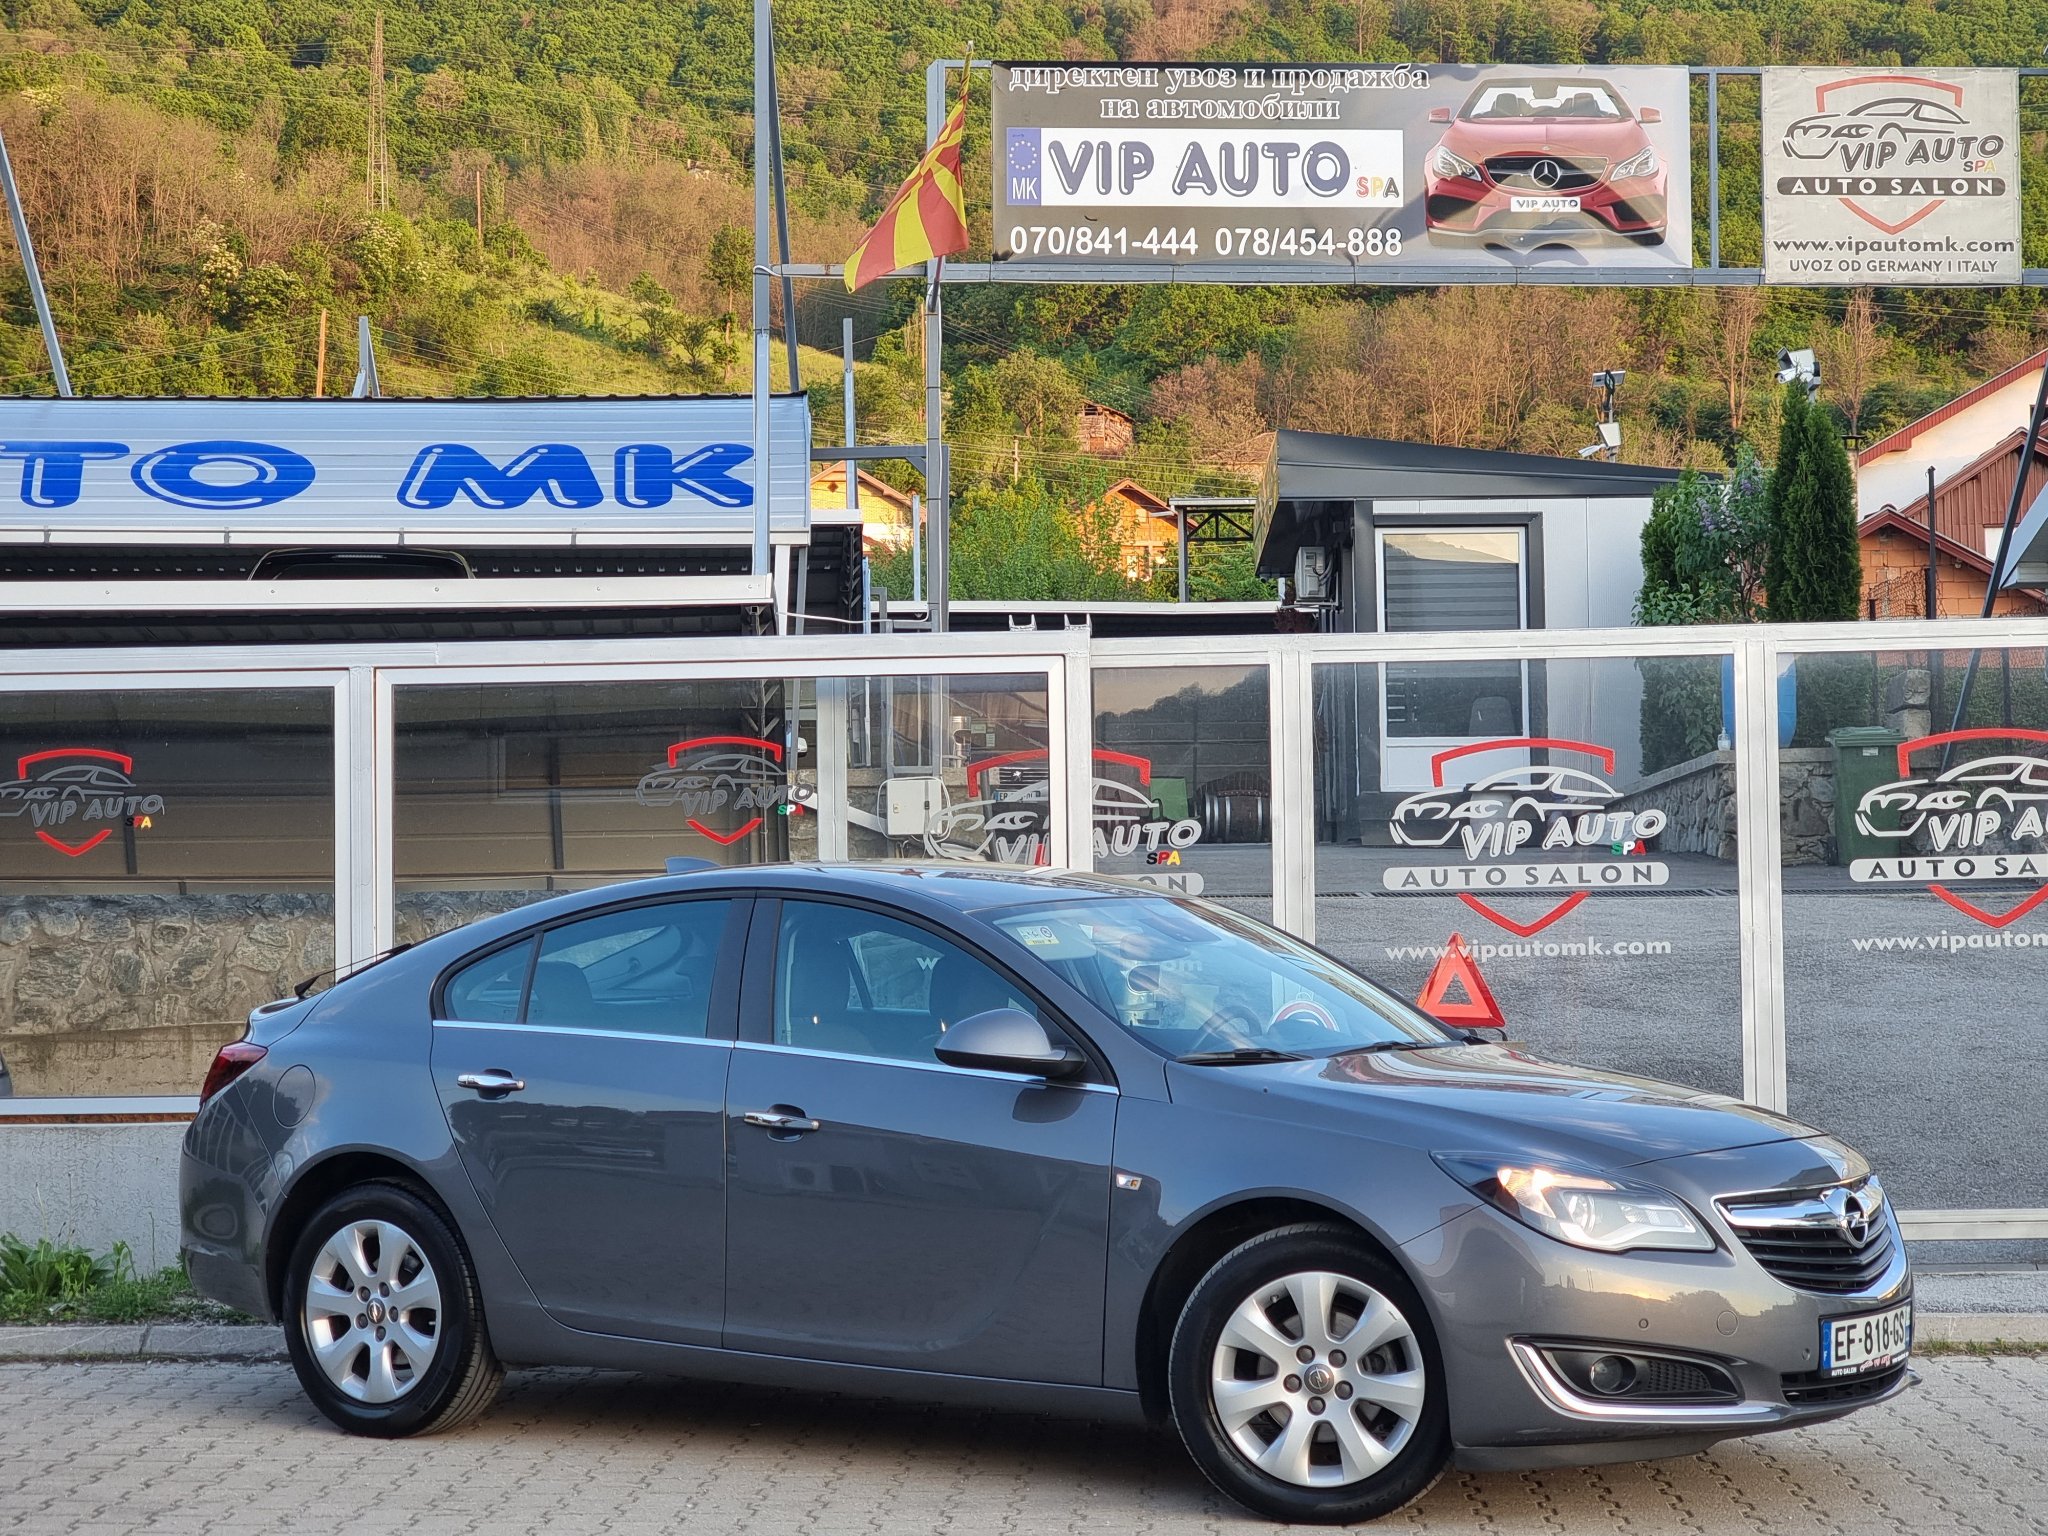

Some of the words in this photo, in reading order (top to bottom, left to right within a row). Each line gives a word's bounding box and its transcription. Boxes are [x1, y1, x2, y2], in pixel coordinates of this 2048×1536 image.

[1009, 66, 1159, 94] директен
[1165, 67, 1236, 94] увоз
[1244, 68, 1265, 88] и
[1272, 64, 1430, 95] продажба
[1100, 98, 1140, 119] на
[1146, 93, 1340, 120] автомобили
[1839, 140, 1897, 173] VIP
[1905, 135, 2004, 166] AUTO
[1963, 160, 1996, 173] SPA
[1048, 140, 1155, 196] VIP
[1172, 140, 1351, 198] AUTO
[1355, 176, 1400, 199] SPA
[1012, 177, 1038, 200] MK
[1791, 178, 1877, 195] AUTO
[1891, 178, 1993, 196] SALON
[1516, 199, 1538, 208] VIP
[1542, 199, 1578, 208] AUTO
[1010, 226, 1198, 255] 070/841-444
[1215, 227, 1403, 256] 078/454-888
[1773, 236, 2015, 255] www.vipautomk.com
[1789, 259, 1833, 273] UVOZ
[1839, 259, 1862, 273] OD
[1866, 260, 1942, 273] GERMANY
[1947, 260, 1952, 273] I
[1957, 260, 1998, 273] ITALY
[397, 443, 754, 509] MK
[31, 801, 77, 827] VIP
[82, 795, 163, 821] AUTO
[681, 789, 728, 817] VIP
[734, 783, 814, 810] AUTO
[778, 804, 804, 816] SPA
[125, 816, 152, 828] SPA
[1928, 811, 2001, 852] VIP
[1461, 820, 1532, 861] VIP
[1542, 809, 1667, 850] AUTO
[1611, 839, 1647, 856] SPA
[1146, 850, 1181, 866] SPA
[1868, 858, 1976, 879] AUTO
[1401, 867, 1507, 888] AUTO
[1525, 864, 1652, 886] SALON
[1385, 936, 1672, 962] www.vipautomk.com
[1835, 1310, 1905, 1362] EF-818-GS
